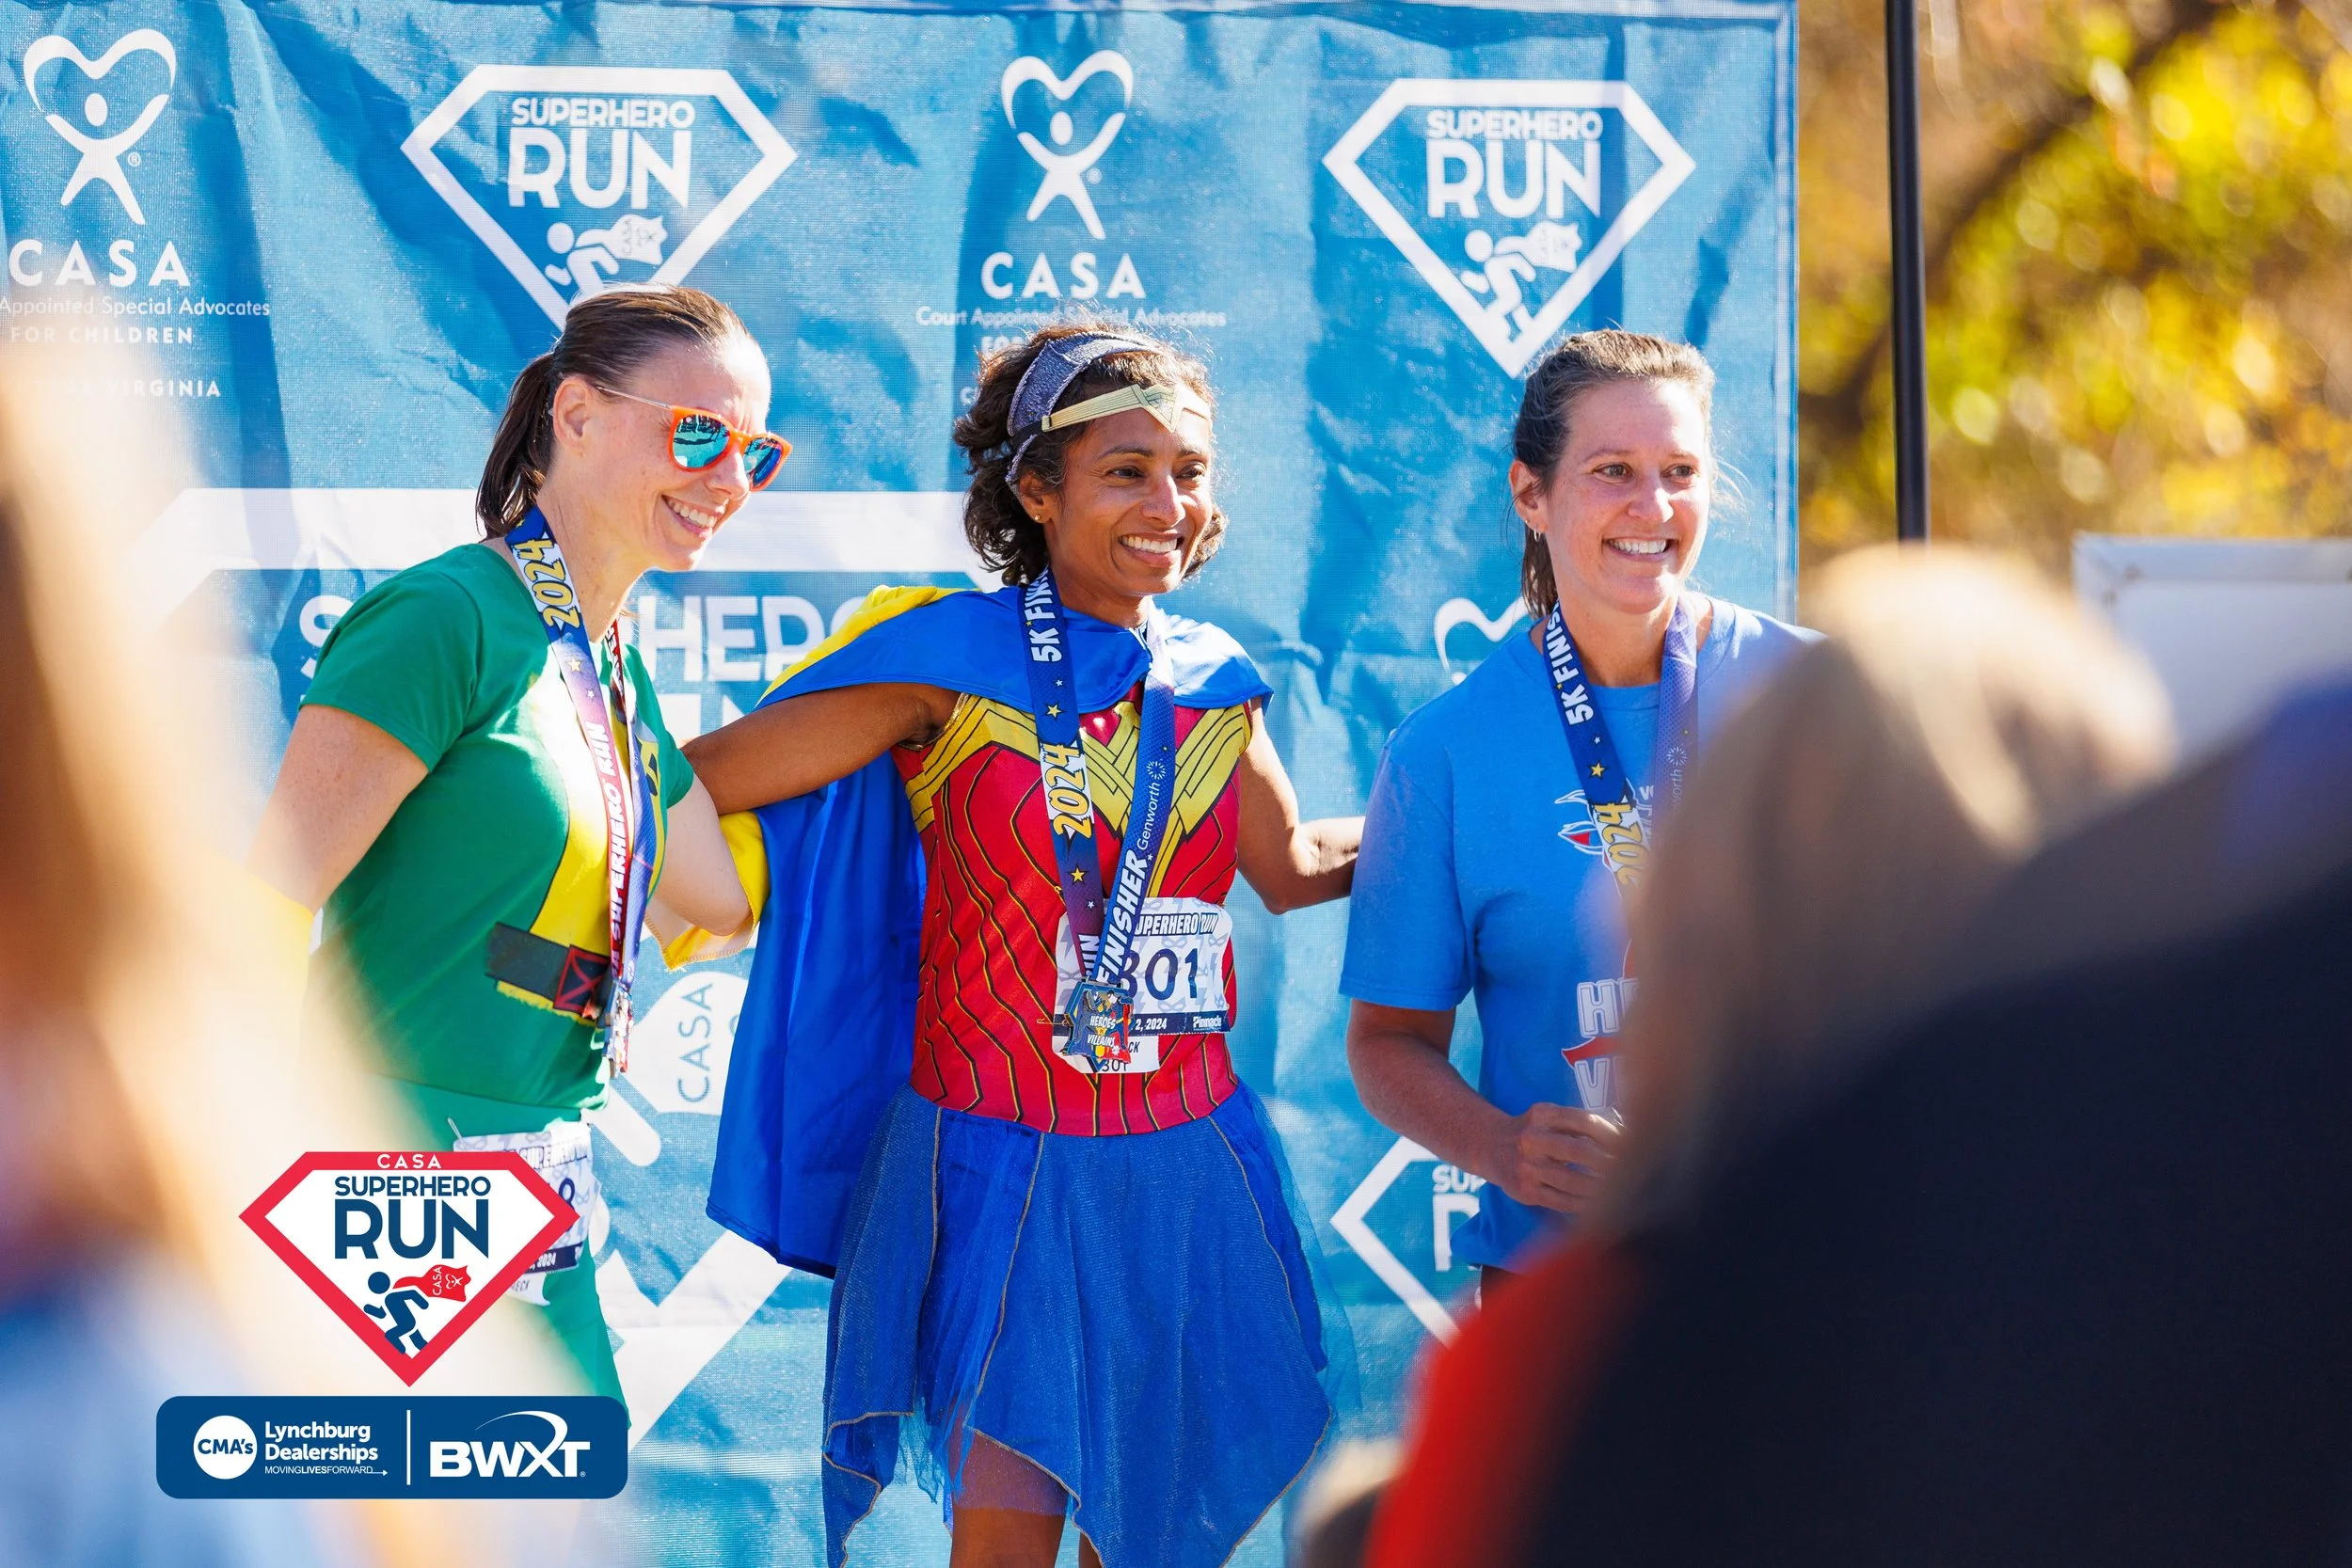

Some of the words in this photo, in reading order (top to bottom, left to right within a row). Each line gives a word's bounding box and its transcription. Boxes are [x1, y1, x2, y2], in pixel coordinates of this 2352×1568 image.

[511, 97, 696, 129] SUPERHERO
[1426, 110, 1604, 140] SUPERHERO
[508, 128, 692, 209] RUN
[1426, 139, 1601, 219] RUN
[8, 238, 191, 287] CASA
[980, 252, 1147, 299] CASA
[0, 295, 94, 318] Appointed
[103, 295, 171, 318] Special
[178, 296, 271, 316] Advocates
[915, 306, 967, 326] Court
[11, 326, 56, 343] FOR
[69, 326, 193, 344] CHILDREN
[105, 379, 222, 397] VIRGINIA
[514, 538, 581, 629] 2024
[1028, 627, 1062, 662] 5K
[1546, 601, 1580, 684] FINIS
[1561, 683, 1595, 726] 5K
[584, 721, 616, 778] RUN
[1042, 743, 1092, 839] 2024
[1136, 781, 1163, 851] Genworth
[1095, 849, 1149, 984] FINISHER
[1135, 912, 1200, 936] UPERHERO
[1200, 912, 1219, 934] RUN
[677, 983, 713, 1103] CASA
[1087, 1034, 1116, 1048] VILLAINS
[1089, 1015, 1117, 1030] HEROES
[1144, 1018, 1168, 1030] 2024
